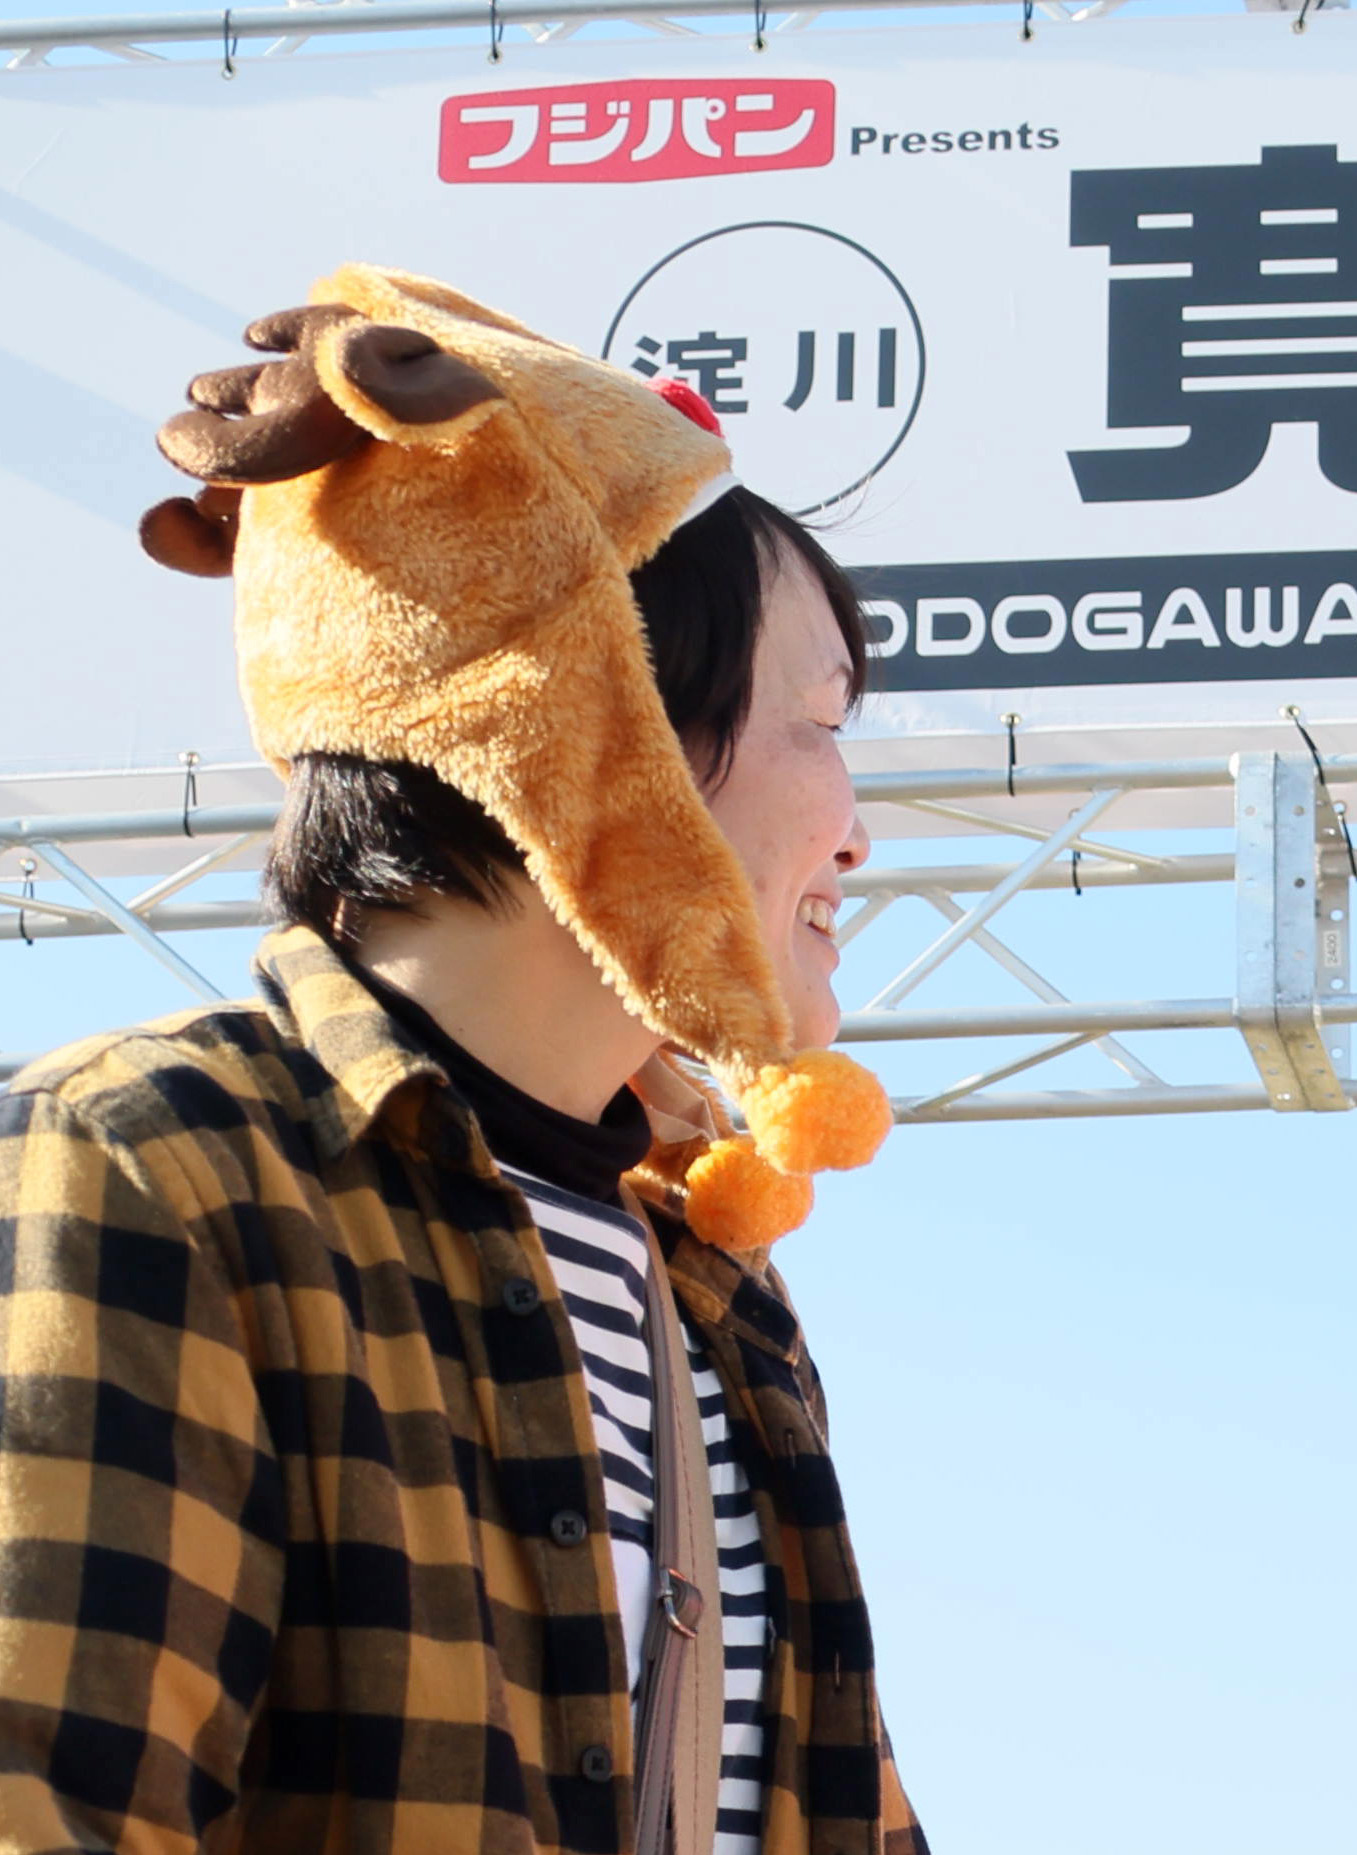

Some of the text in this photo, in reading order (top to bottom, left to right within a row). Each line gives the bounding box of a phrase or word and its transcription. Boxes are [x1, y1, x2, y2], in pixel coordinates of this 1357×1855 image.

[459, 92, 816, 170] フジパン
[850, 120, 1061, 156] Presents
[630, 326, 898, 413] 淀川
